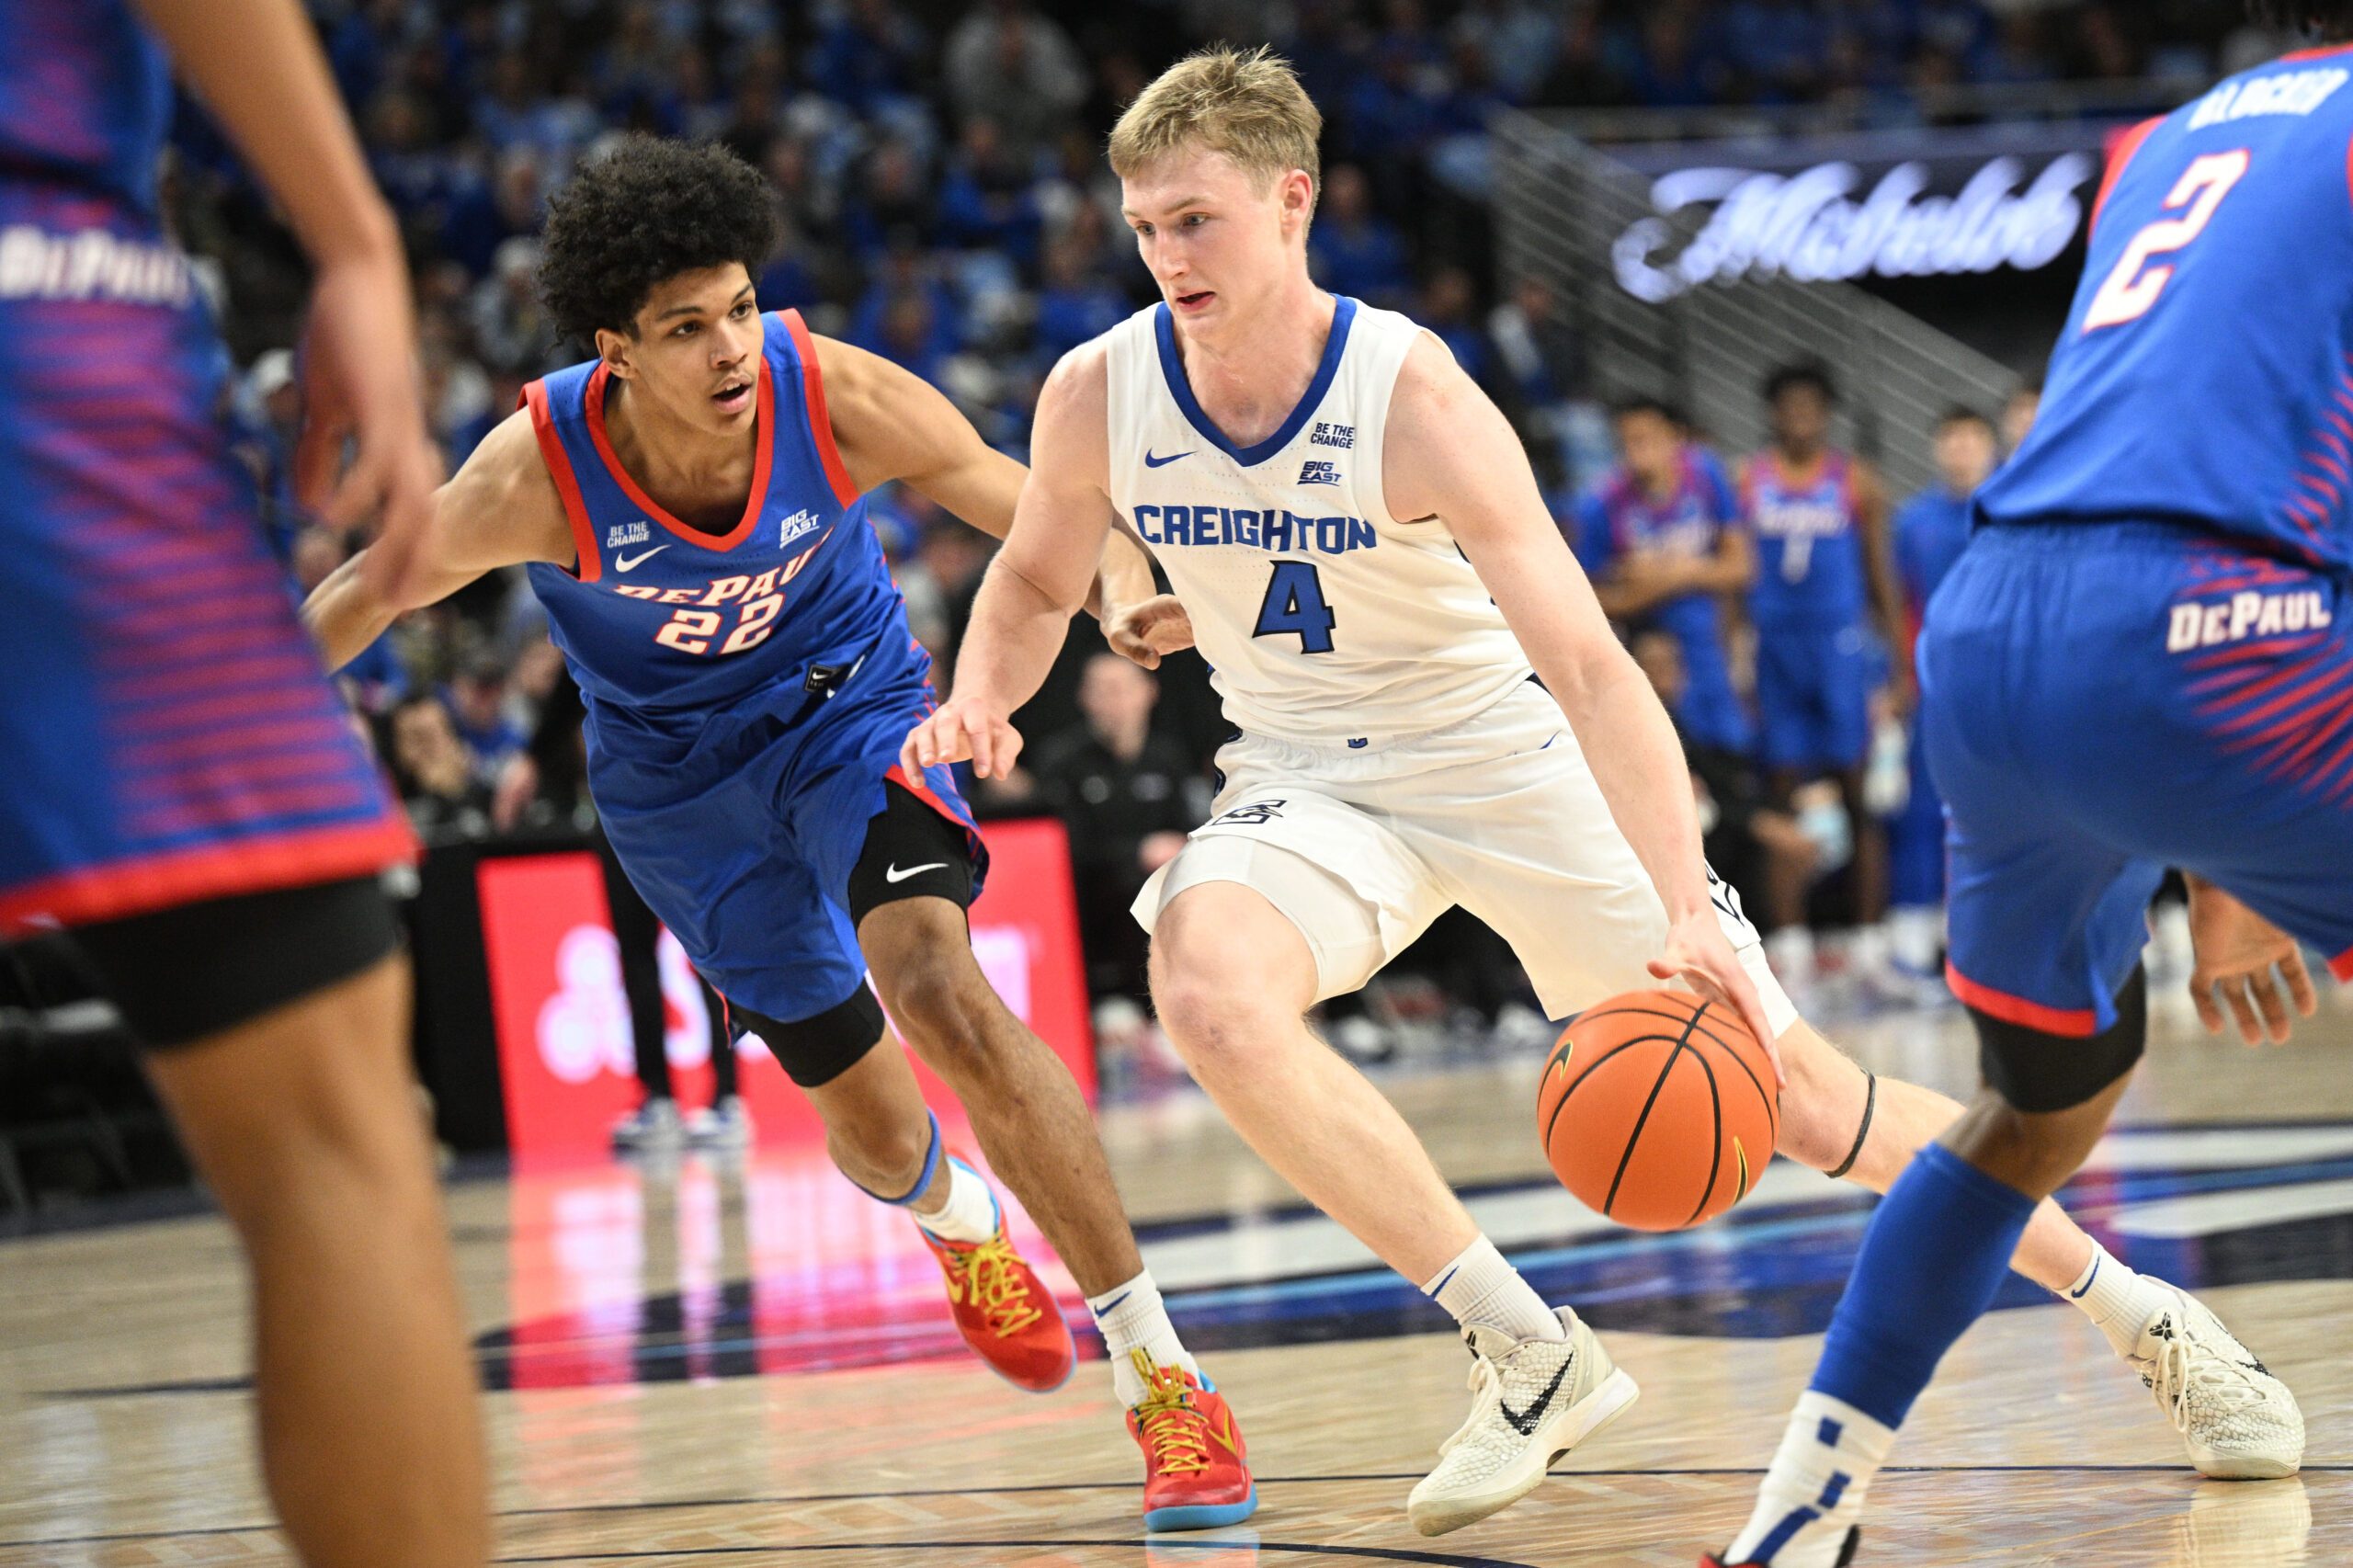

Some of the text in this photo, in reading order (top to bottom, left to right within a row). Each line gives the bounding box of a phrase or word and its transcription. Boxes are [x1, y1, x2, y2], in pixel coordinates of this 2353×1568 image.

[2082, 145, 2251, 337] 2
[1310, 433, 1355, 449] CHANGE
[1315, 422, 1356, 438] BE THE
[1299, 471, 1342, 483] EAST
[1302, 460, 1335, 472] BIG
[610, 520, 648, 538] BE THE
[779, 514, 820, 543] EAST
[780, 508, 808, 530] BIG
[1132, 505, 1378, 555] CREIGHTON
[607, 530, 650, 549] CHANGE
[613, 523, 835, 607] DEPAU
[1252, 559, 1336, 654] 4
[654, 592, 785, 656] 22
